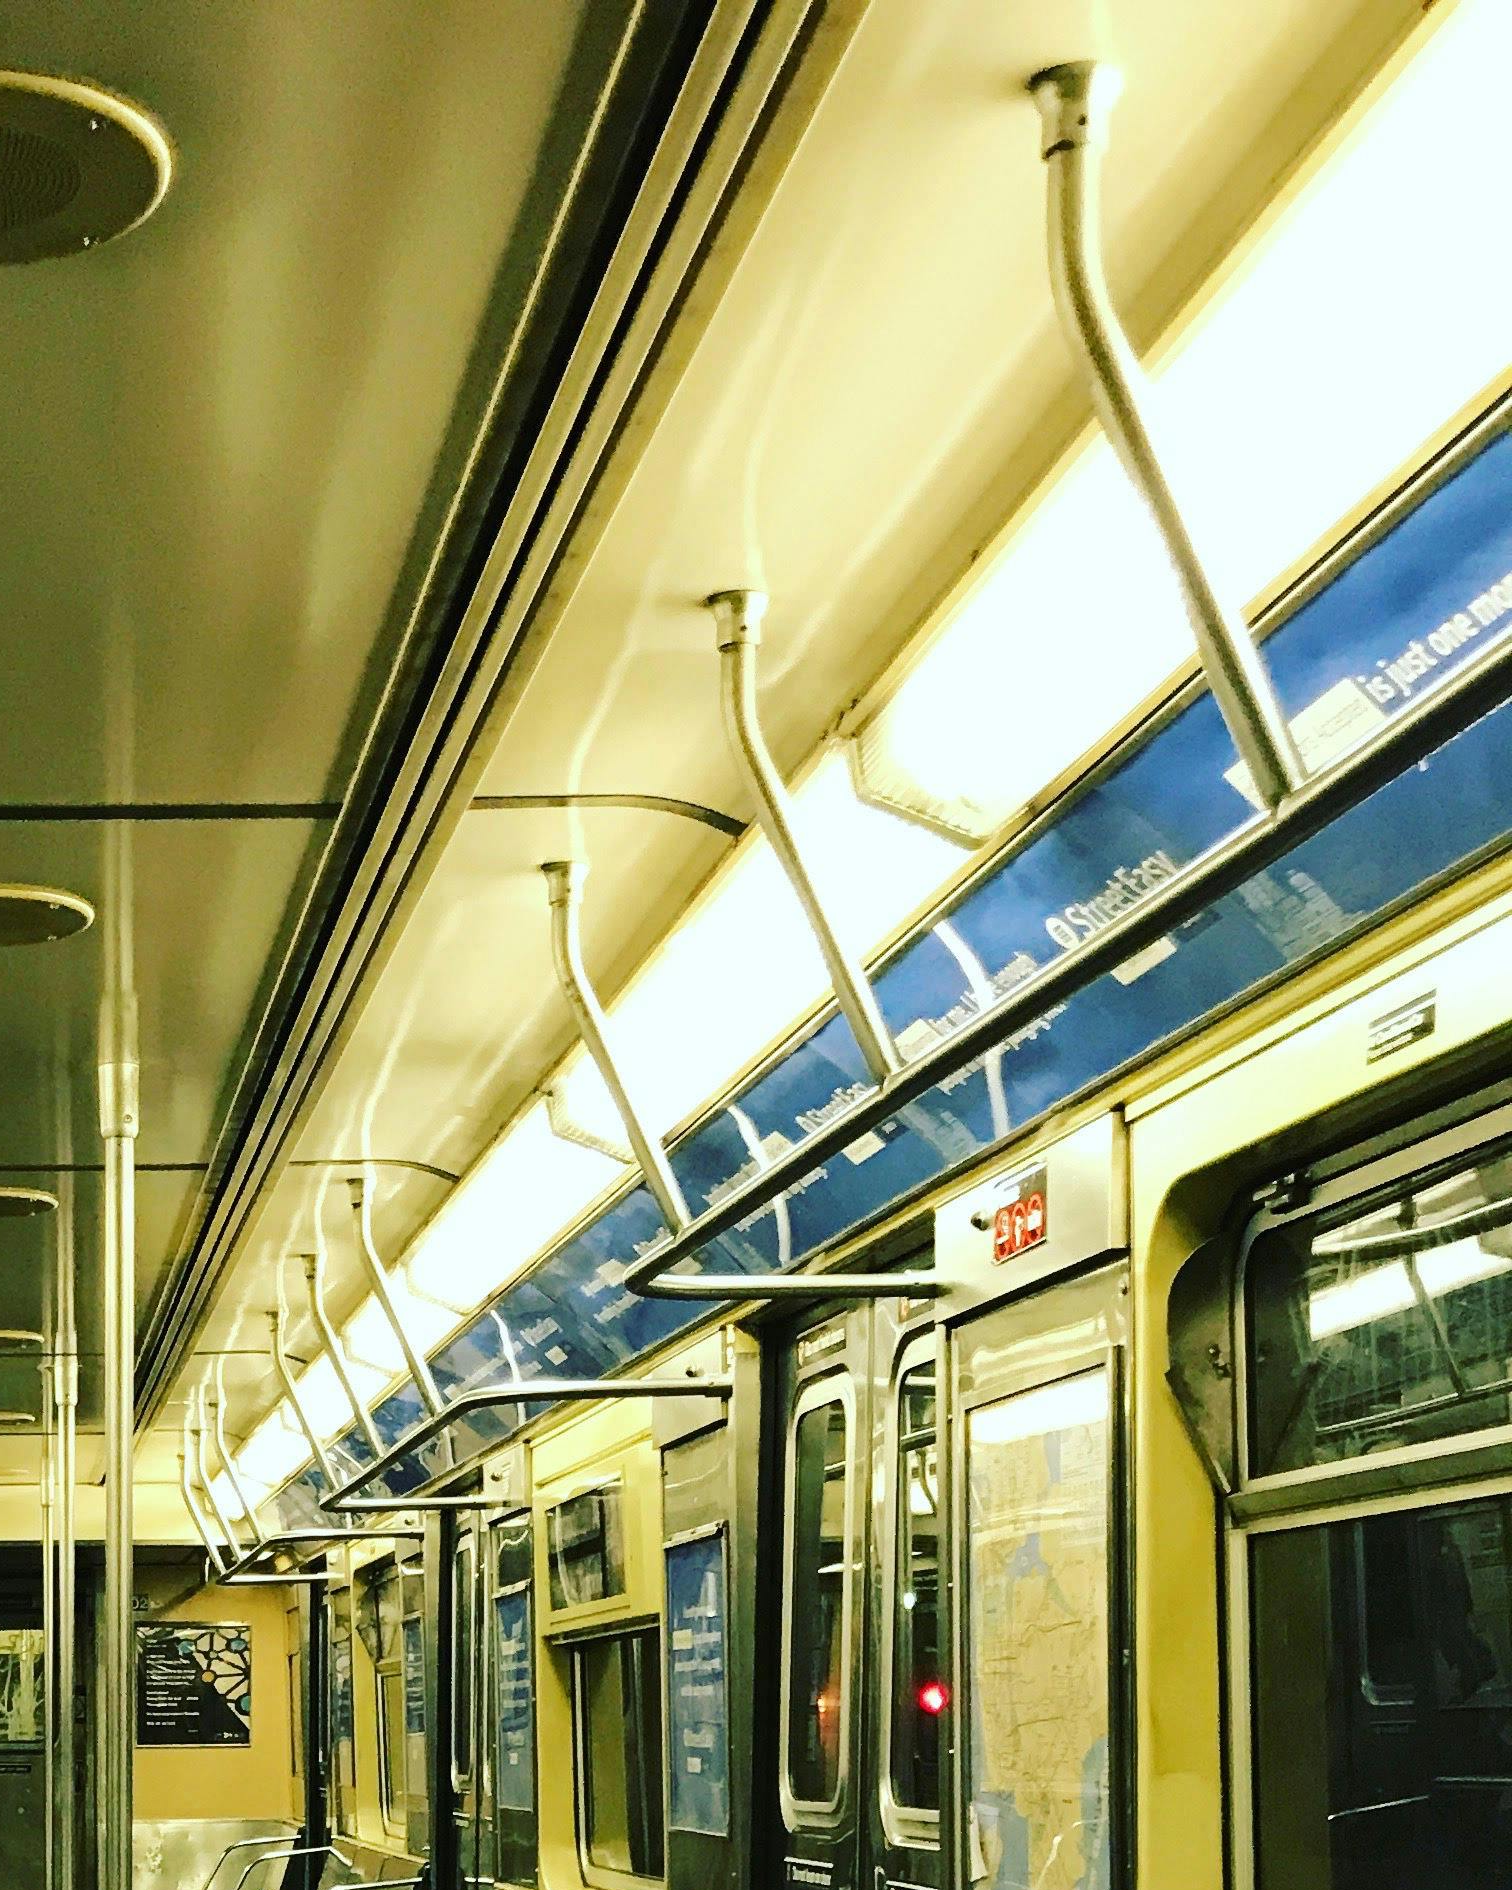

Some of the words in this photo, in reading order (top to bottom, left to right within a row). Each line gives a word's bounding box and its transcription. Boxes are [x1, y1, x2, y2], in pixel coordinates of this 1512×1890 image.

[1357, 675, 1395, 704] is
[1376, 641, 1438, 697] just
[1427, 613, 1481, 656] one
